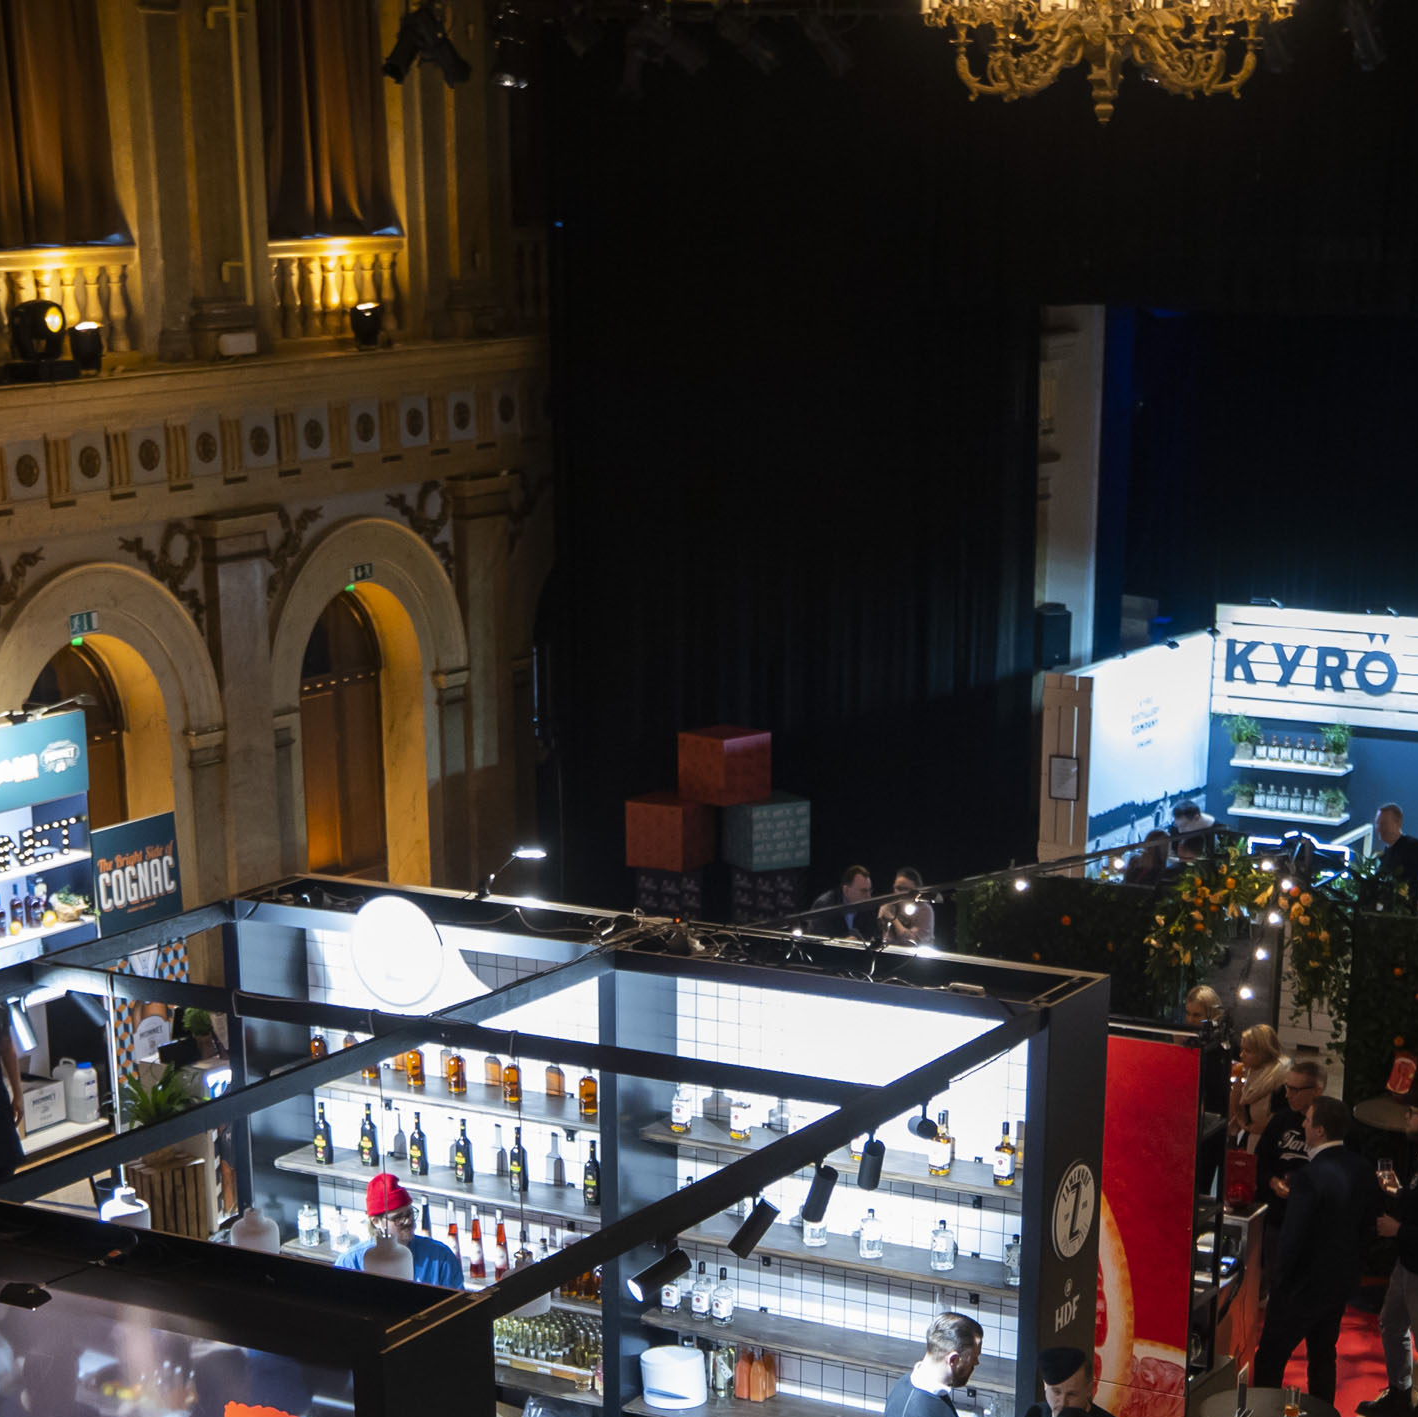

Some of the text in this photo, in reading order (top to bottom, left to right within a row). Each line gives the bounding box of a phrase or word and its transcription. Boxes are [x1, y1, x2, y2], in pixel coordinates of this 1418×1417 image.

[1223, 634, 1398, 697] KYRÖ
[98, 855, 177, 913] COGNAC
[1054, 1294, 1080, 1333] HDF
